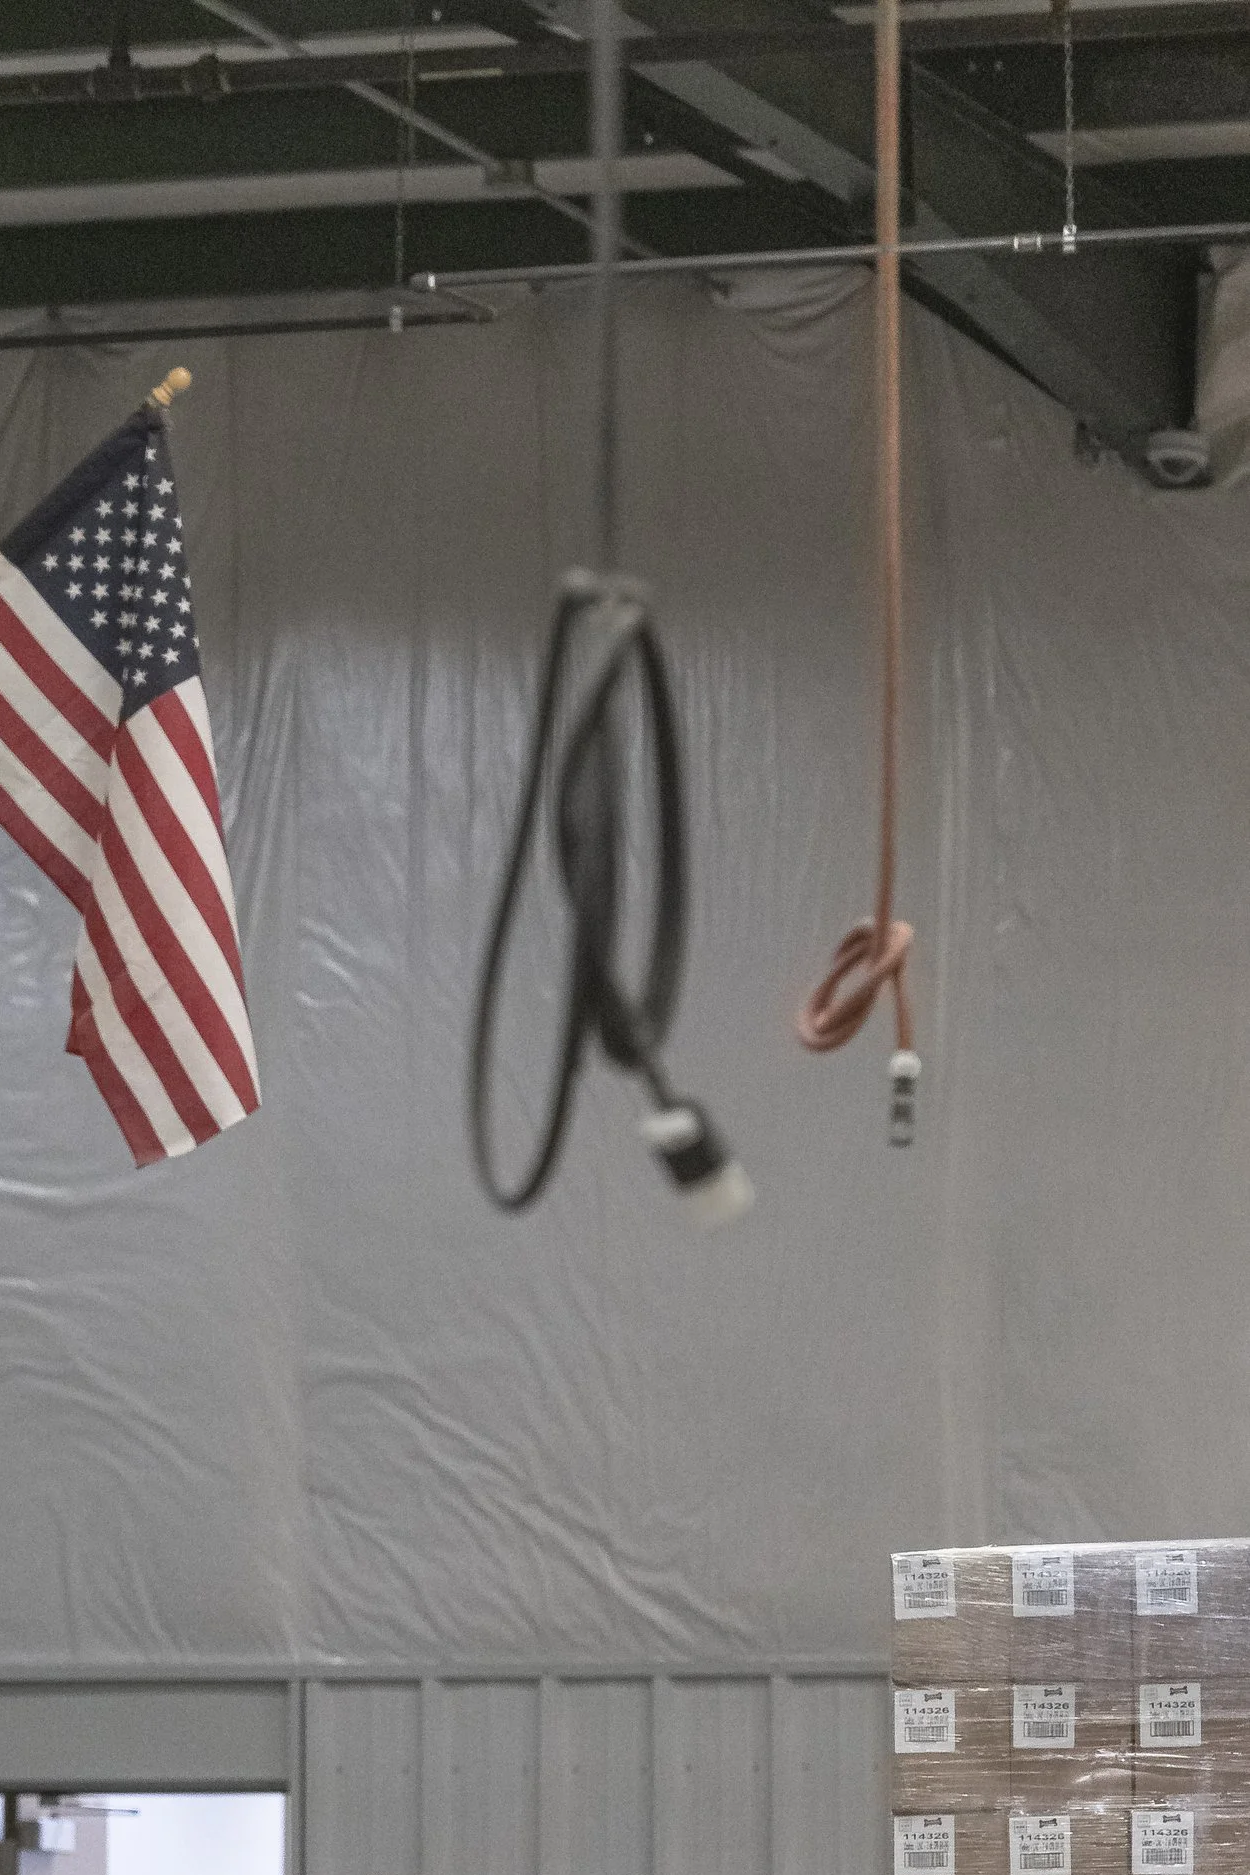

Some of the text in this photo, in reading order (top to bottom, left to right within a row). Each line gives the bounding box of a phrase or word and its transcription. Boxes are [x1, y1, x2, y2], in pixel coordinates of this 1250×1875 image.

[1023, 1702, 1070, 1710] 114326
[1149, 1701, 1196, 1709] 114326
[904, 1707, 949, 1715] 114326
[903, 1832, 949, 1840] 114326
[1019, 1833, 1065, 1841] 114326
